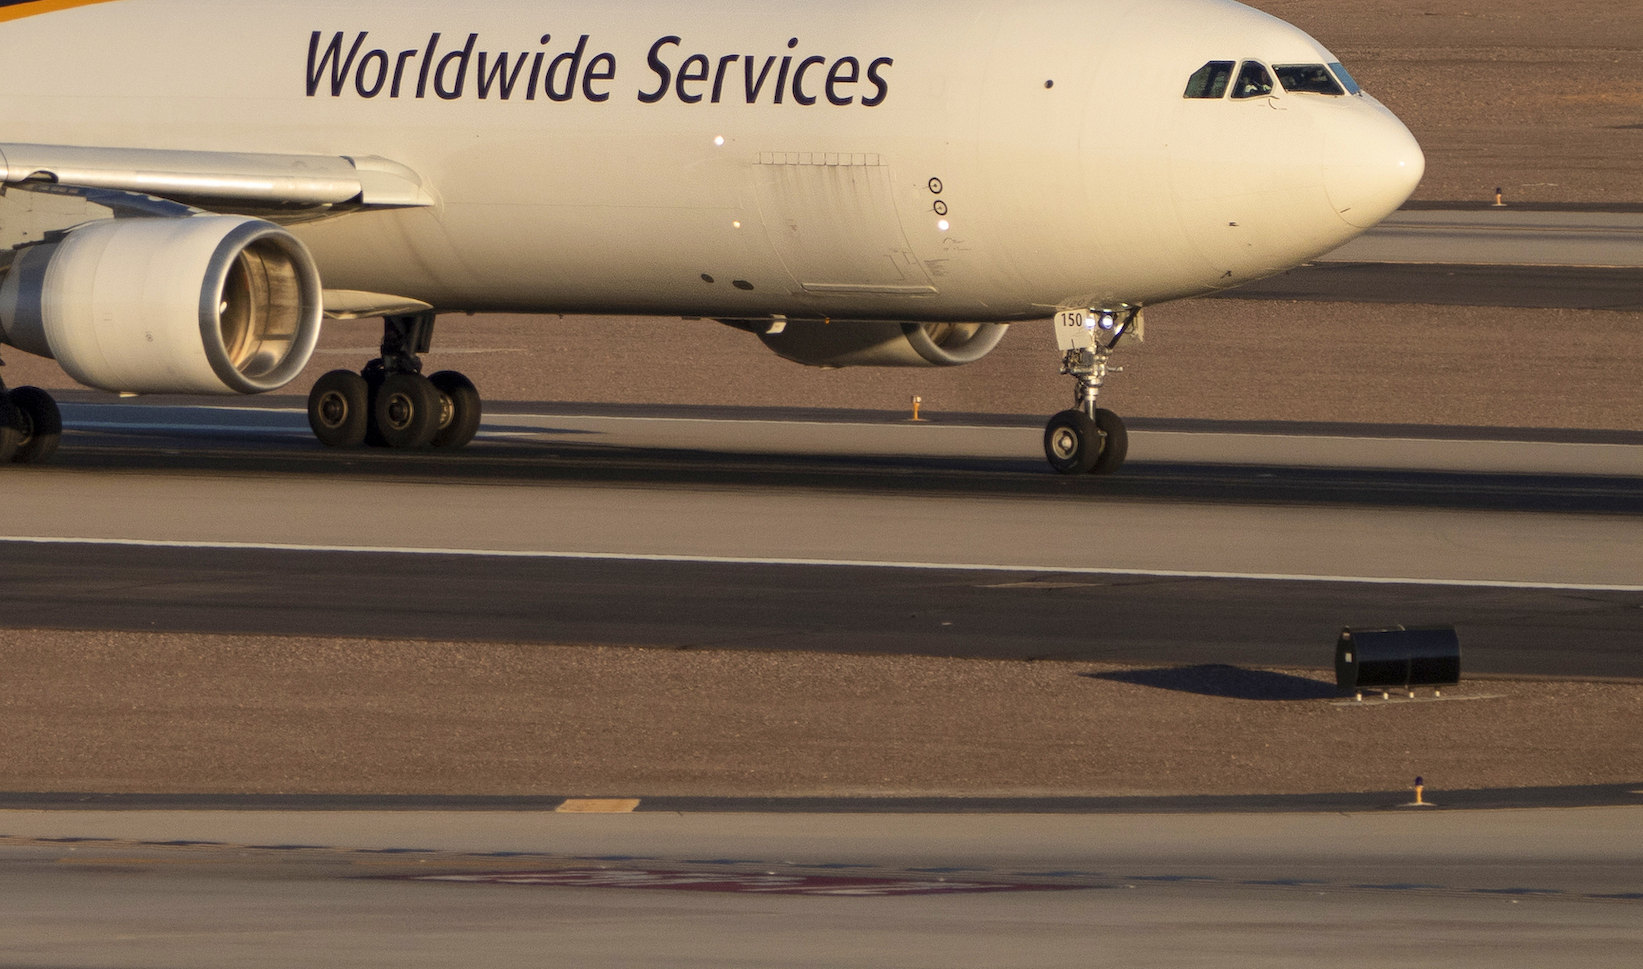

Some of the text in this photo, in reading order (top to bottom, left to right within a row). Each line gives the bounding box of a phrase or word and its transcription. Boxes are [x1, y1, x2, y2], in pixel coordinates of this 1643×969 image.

[306, 31, 894, 107] Worldwide Services
[1061, 312, 1083, 327] 150
